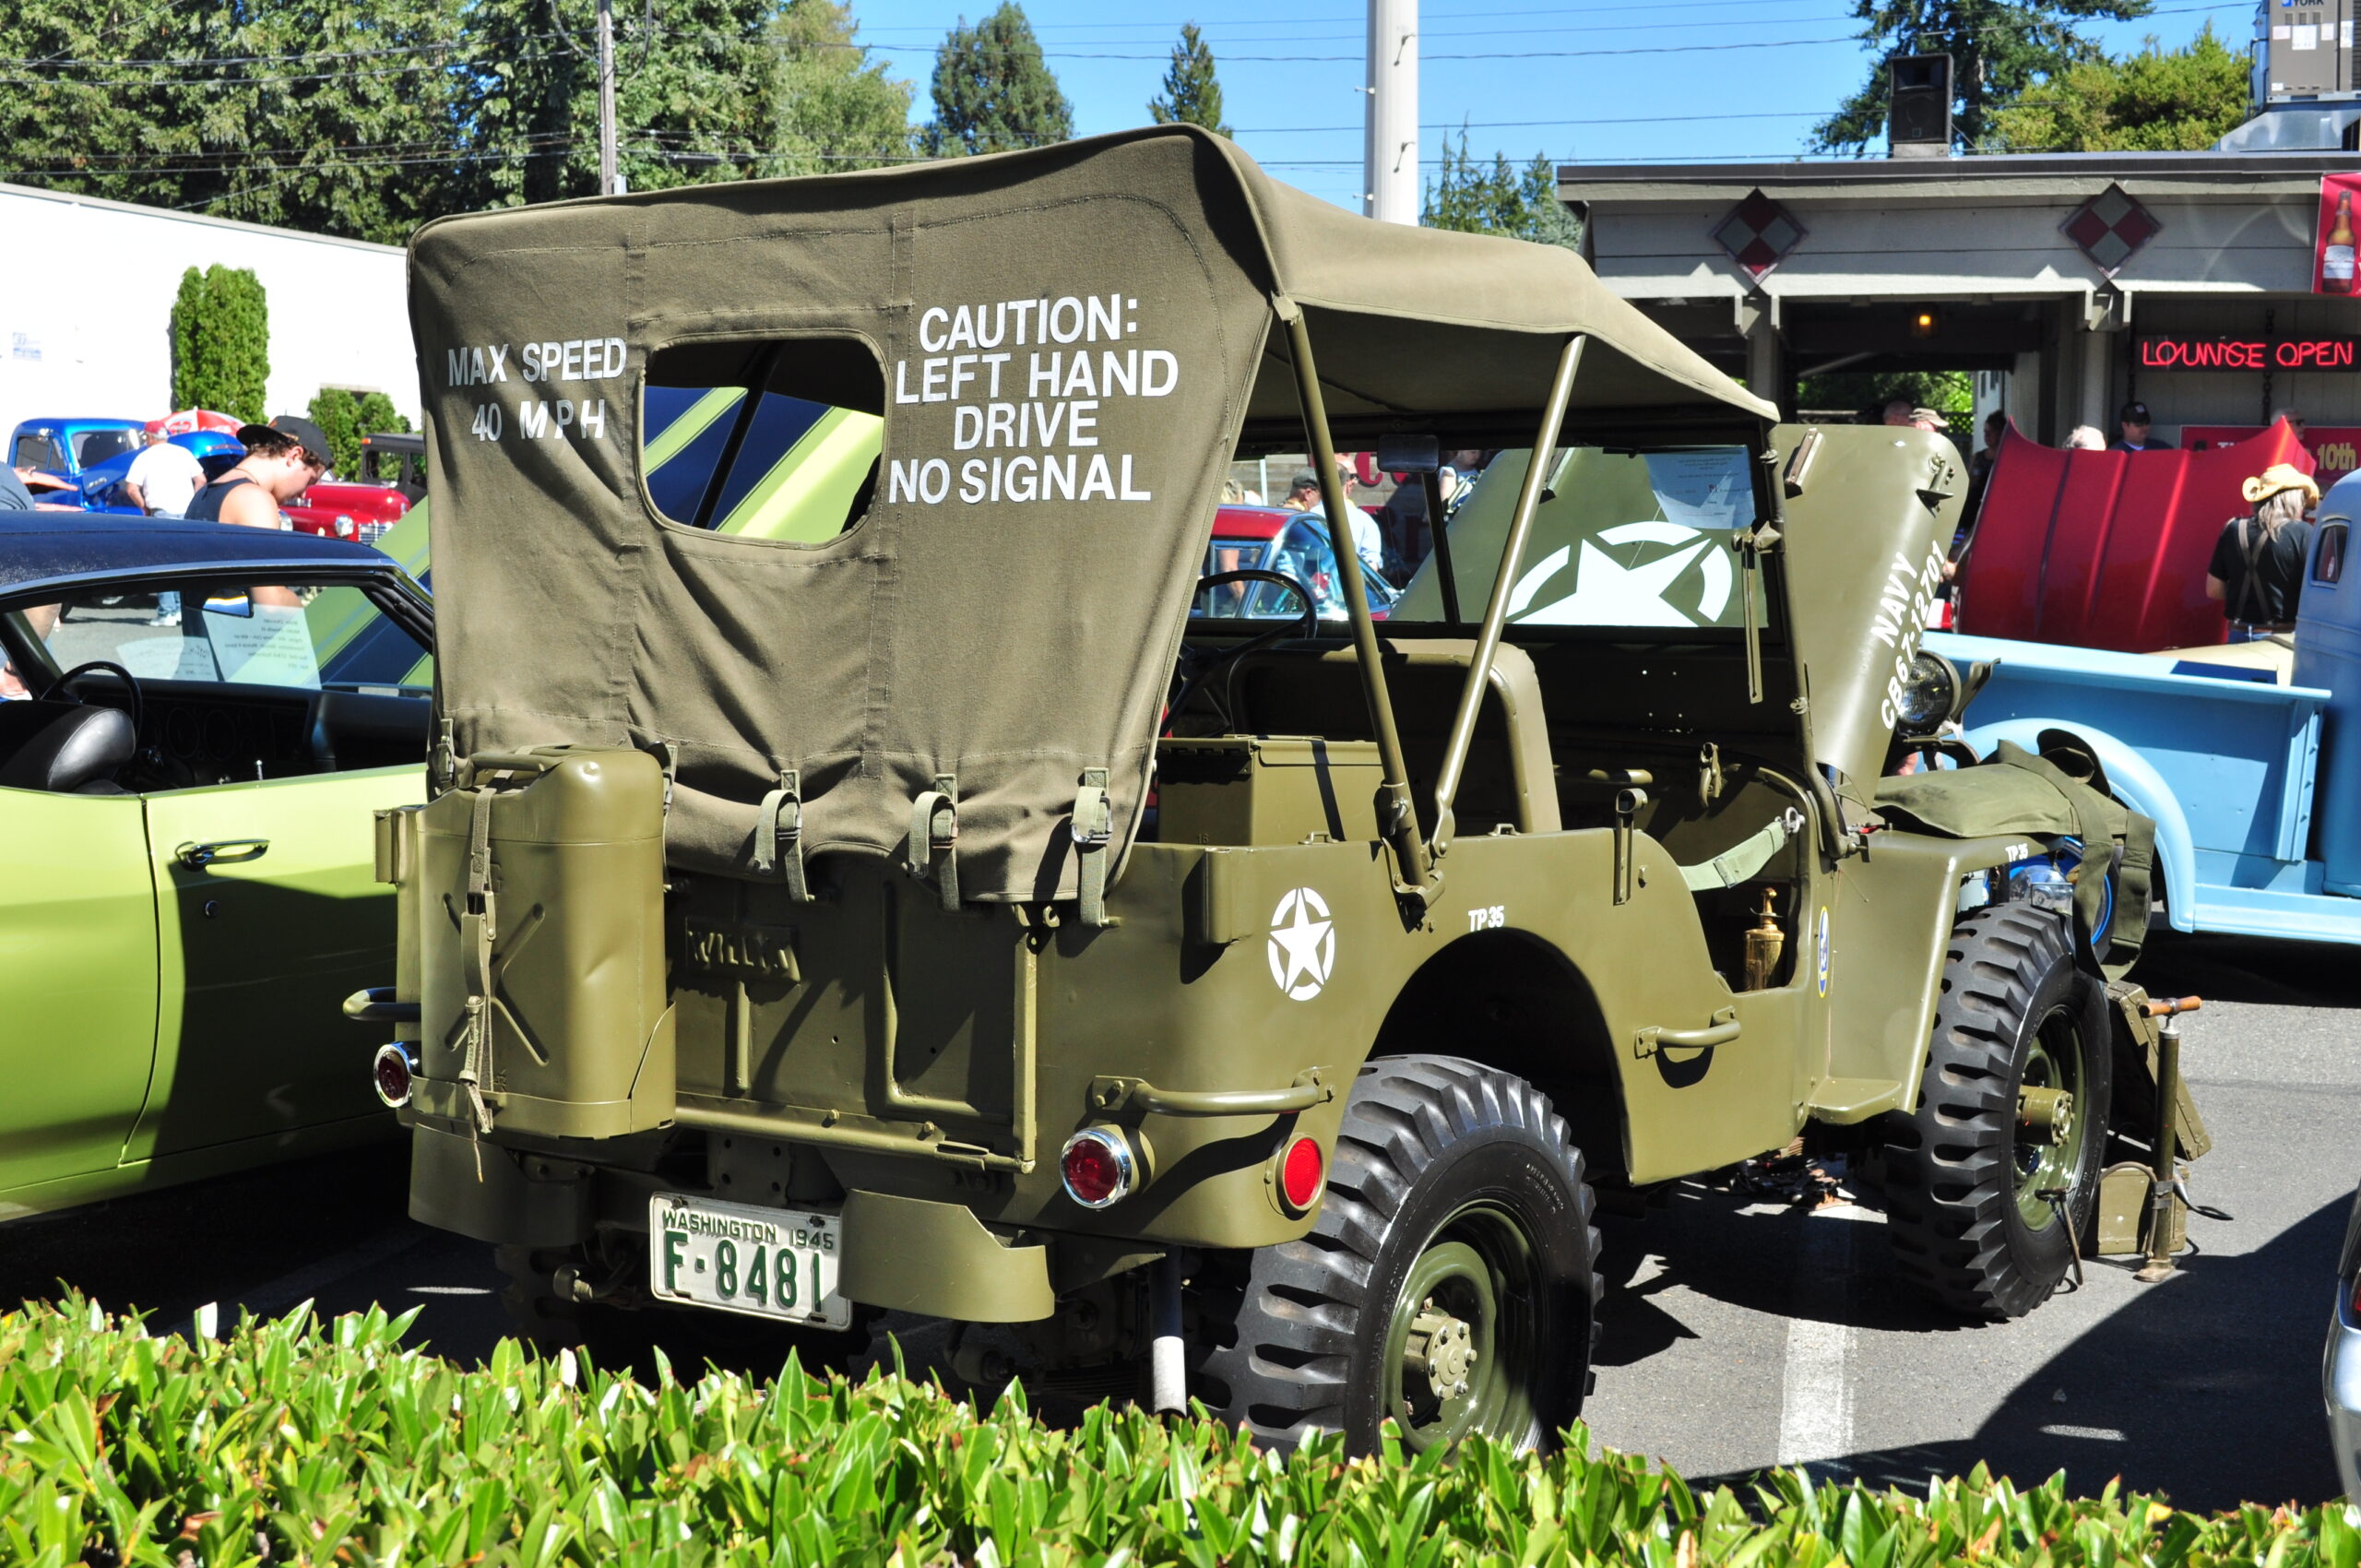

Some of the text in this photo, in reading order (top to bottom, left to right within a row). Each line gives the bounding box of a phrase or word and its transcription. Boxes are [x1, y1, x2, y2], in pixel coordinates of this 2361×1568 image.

[919, 293, 1137, 352] CAUTION:
[448, 338, 627, 386] MAX SPEED
[896, 349, 1179, 404] LEFT HAND
[2142, 340, 2354, 367] LOUNGE OPEN
[471, 403, 503, 442] 40
[954, 399, 1098, 450] DRIVE
[888, 454, 1151, 504] NO SIGNAL
[2317, 443, 2356, 470] 10th
[1870, 552, 1917, 648] NAVY
[663, 1208, 834, 1251] WASHINGTON 1945
